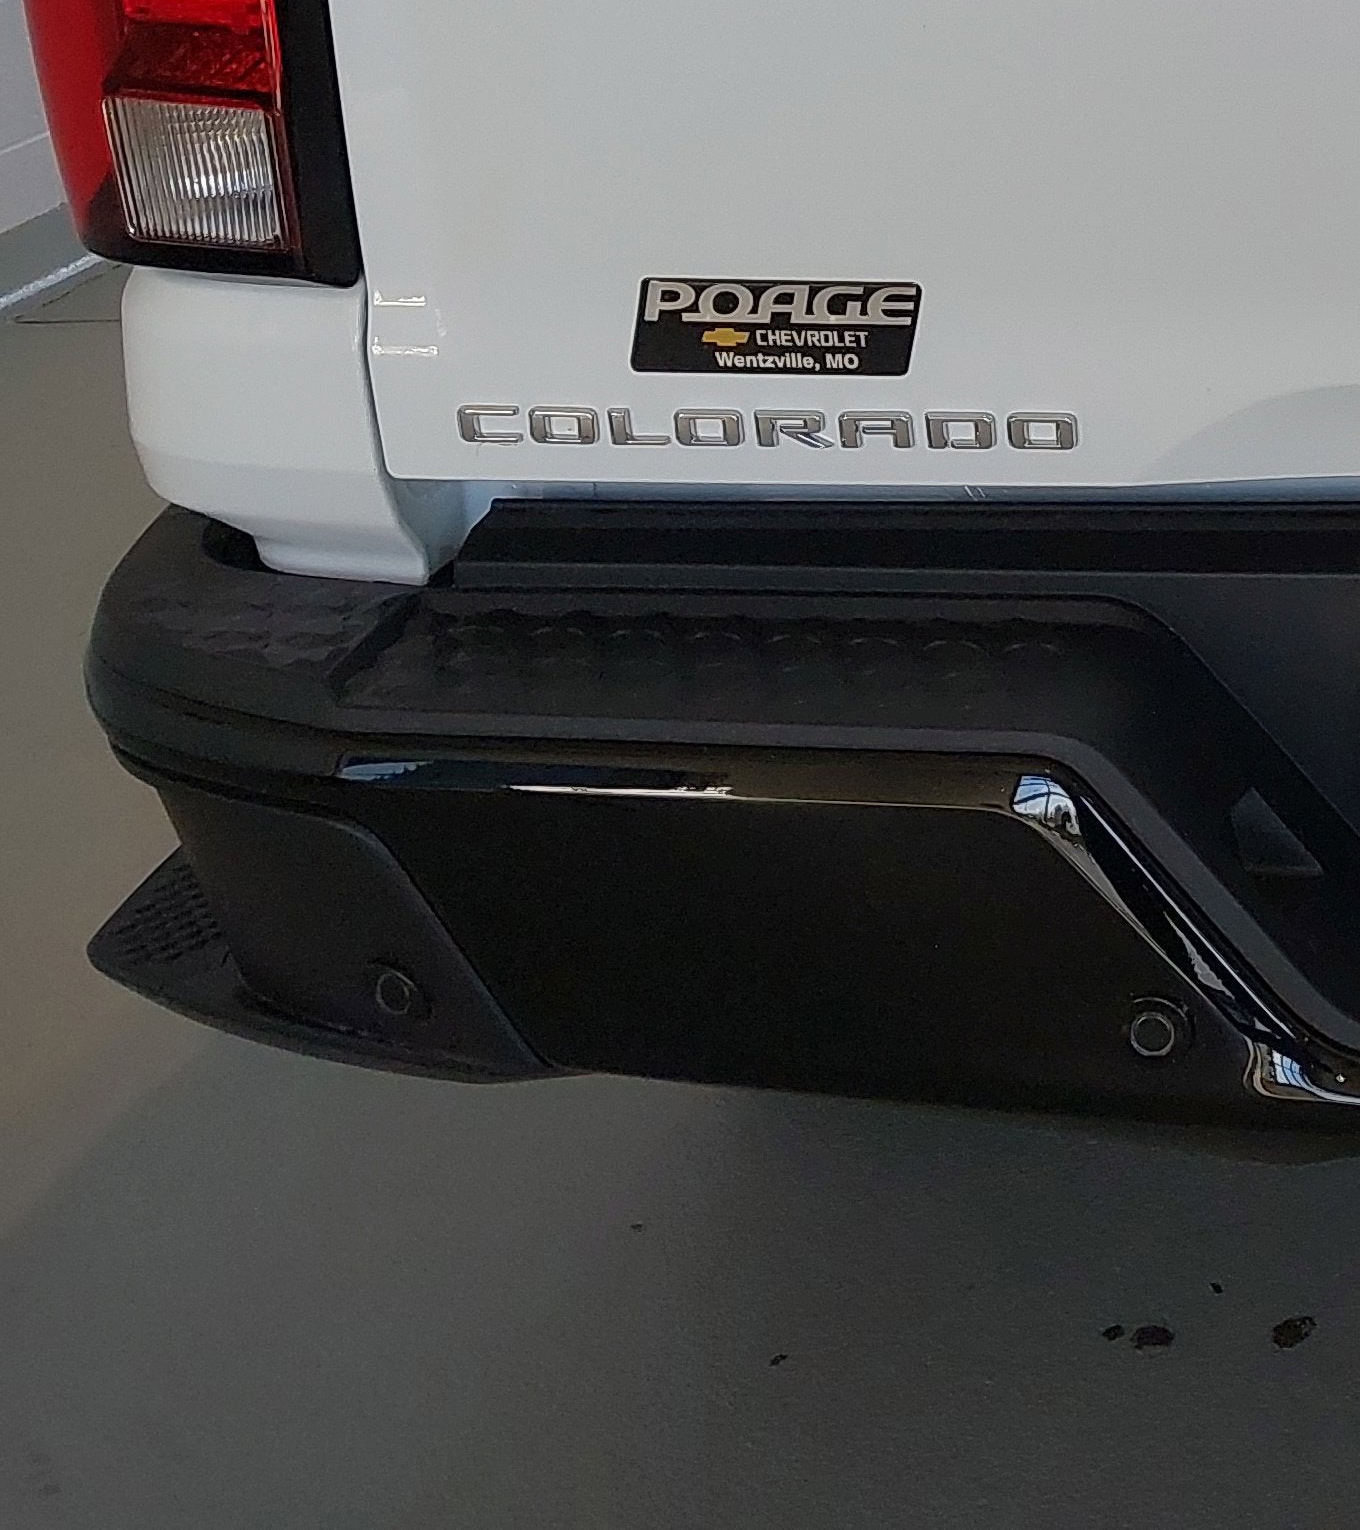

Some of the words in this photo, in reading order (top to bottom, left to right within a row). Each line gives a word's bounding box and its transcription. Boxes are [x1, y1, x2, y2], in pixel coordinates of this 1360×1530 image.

[645, 280, 917, 326] POAGE
[755, 328, 869, 349] CHEVROLET
[715, 351, 820, 371] Wentzville,
[825, 352, 859, 370] MO
[457, 404, 1079, 451] COLORADO
